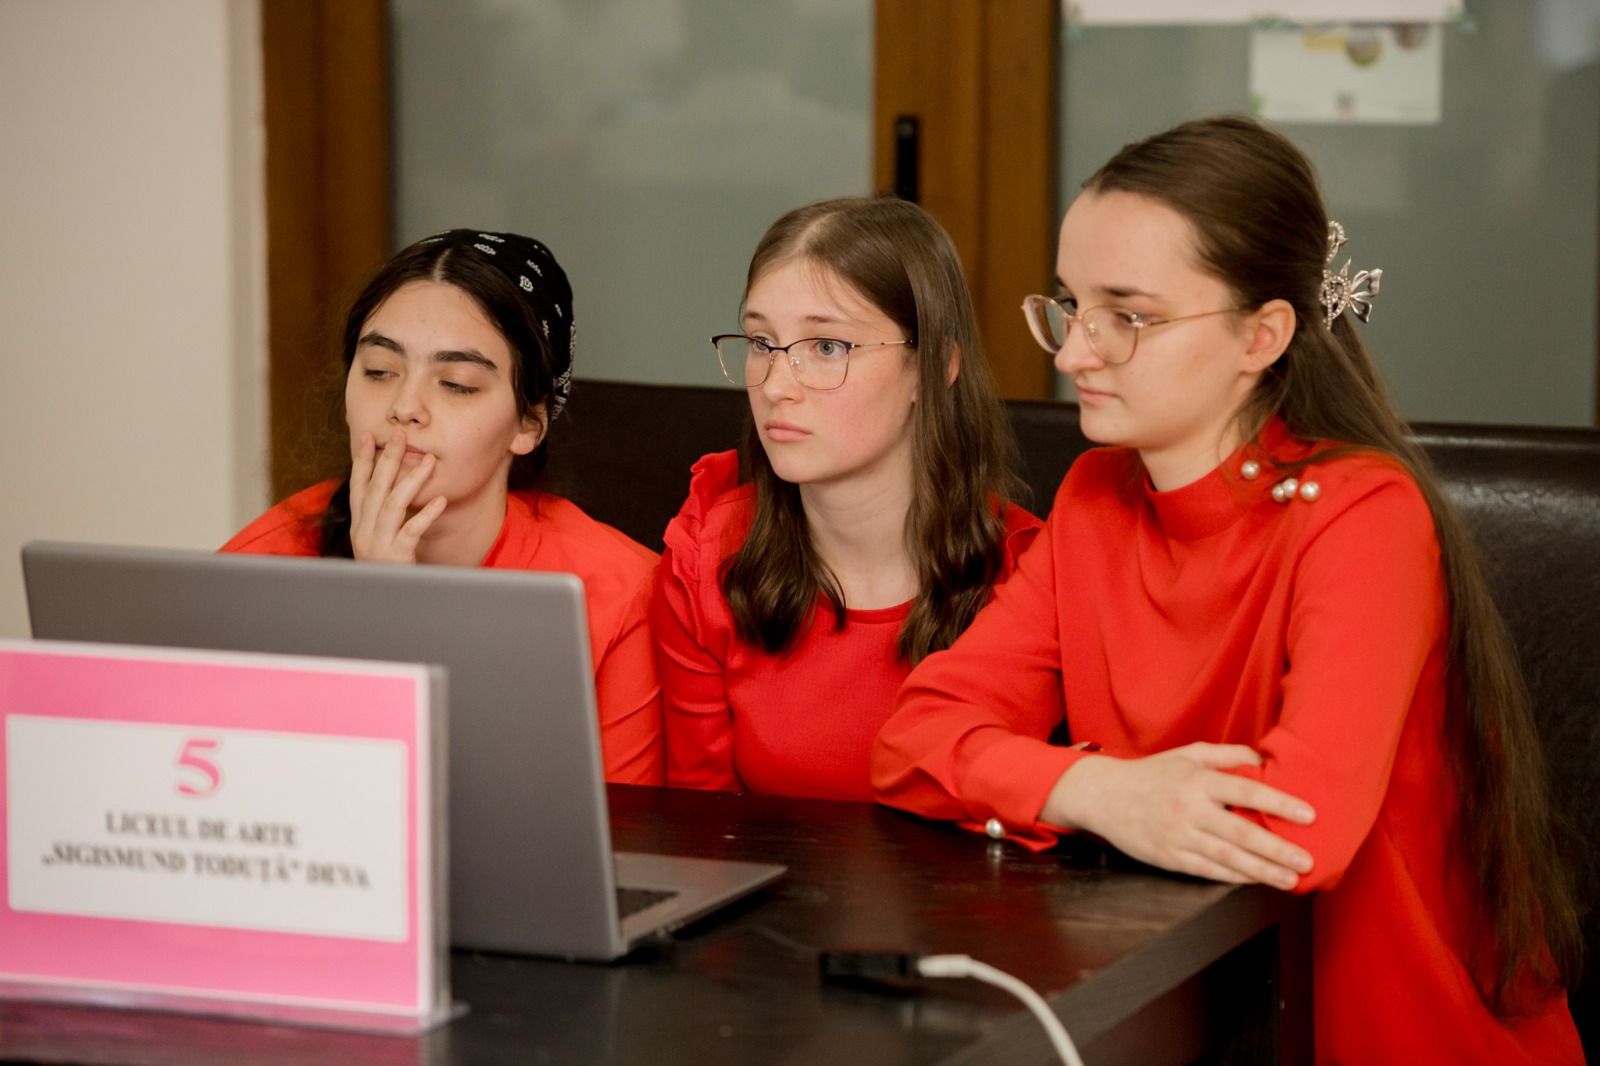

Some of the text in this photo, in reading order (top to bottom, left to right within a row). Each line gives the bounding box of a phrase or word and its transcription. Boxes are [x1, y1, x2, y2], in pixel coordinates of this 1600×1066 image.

[176, 738, 221, 796] 5
[105, 811, 299, 848] LICEUL DE ARTE
[306, 863, 371, 889] DEVA
